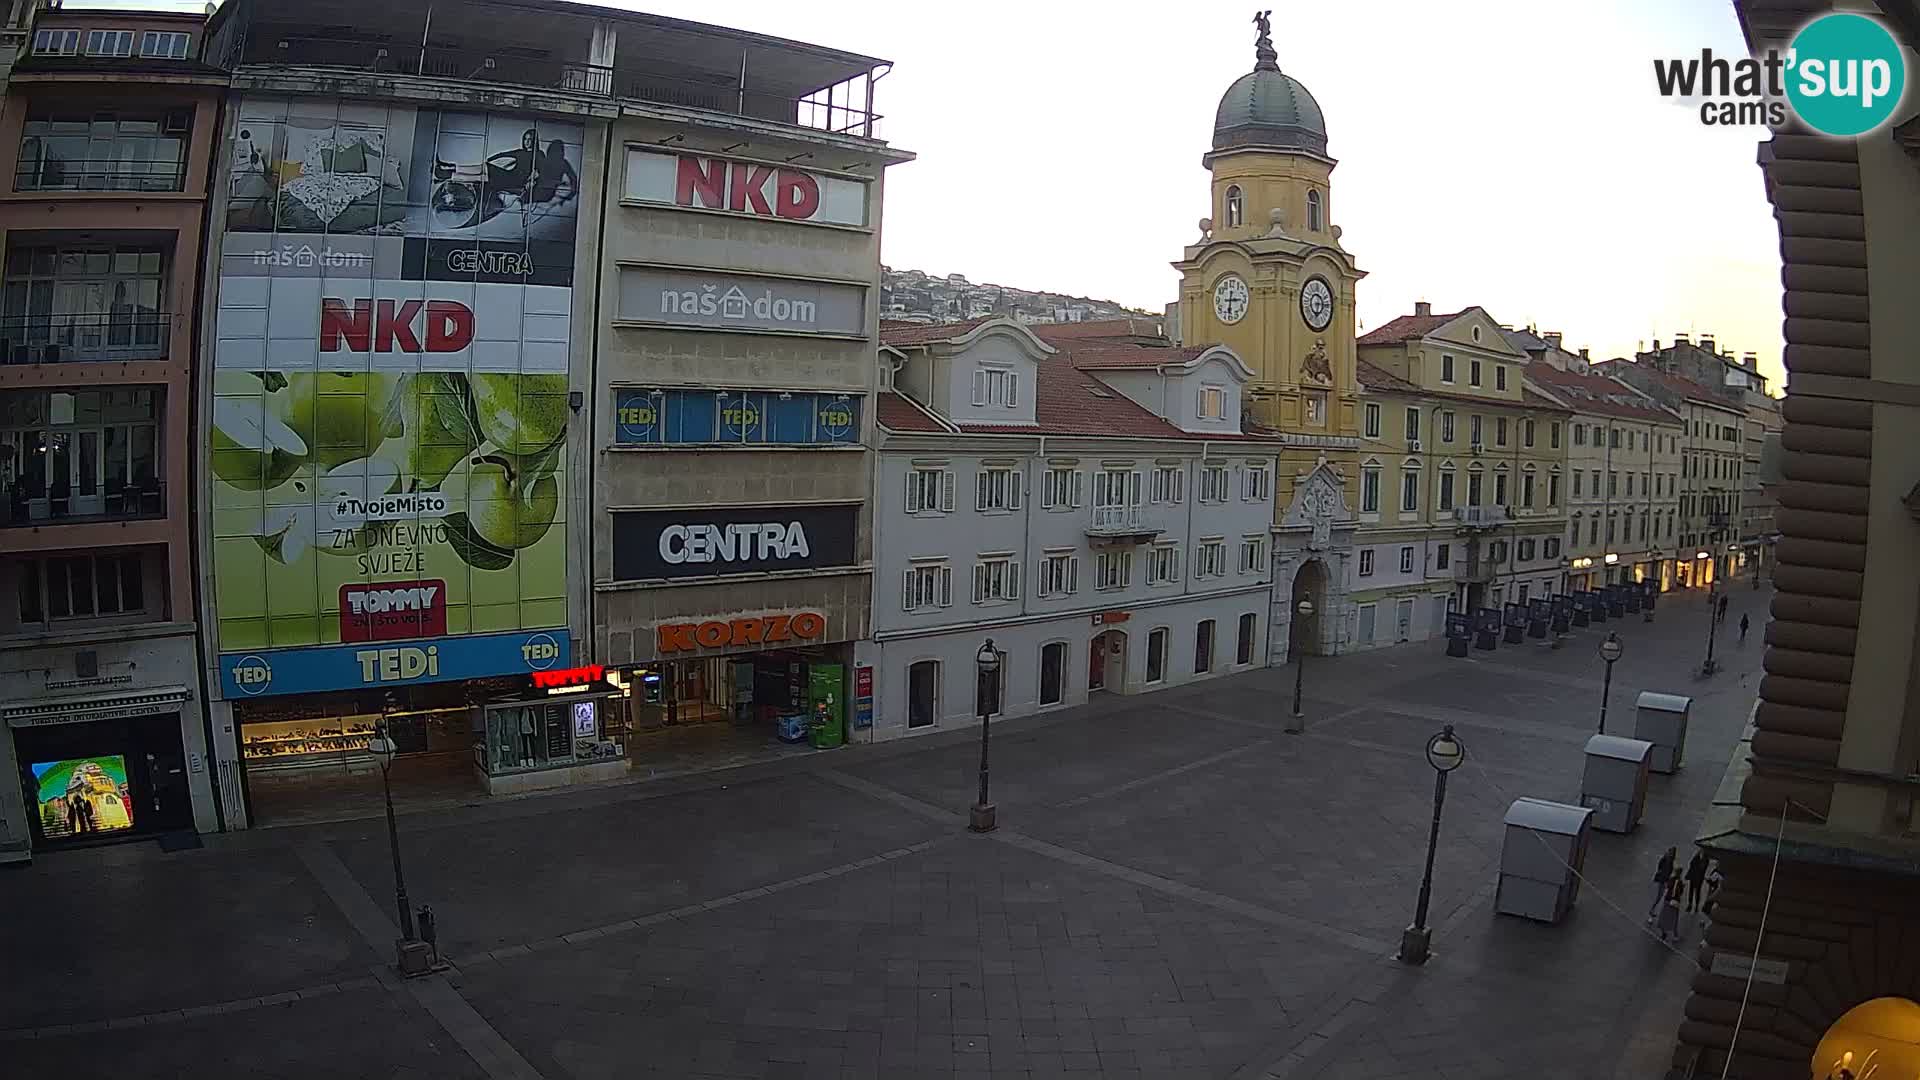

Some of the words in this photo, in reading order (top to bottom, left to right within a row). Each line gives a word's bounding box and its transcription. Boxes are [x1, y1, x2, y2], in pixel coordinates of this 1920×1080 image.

[676, 157, 820, 219] NKD
[318, 247, 366, 268] dom
[447, 249, 535, 275] CENTRA
[661, 284, 717, 316] naš
[753, 290, 816, 323] dom
[320, 297, 476, 353] NKD
[618, 408, 657, 425] TEDi
[723, 409, 759, 426] TEDi
[819, 411, 853, 426] TEDi
[337, 497, 445, 516] #TvojeMisto
[332, 528, 356, 549] ZA
[367, 524, 449, 547] DNEVNO
[658, 520, 810, 564] CENTRA
[358, 547, 425, 575] SVJEŽE
[348, 586, 438, 615] TOMMY
[657, 612, 826, 653] KORZO
[356, 646, 439, 682] TEDi
[521, 641, 559, 661] TEDi
[232, 666, 272, 684] TEDi
